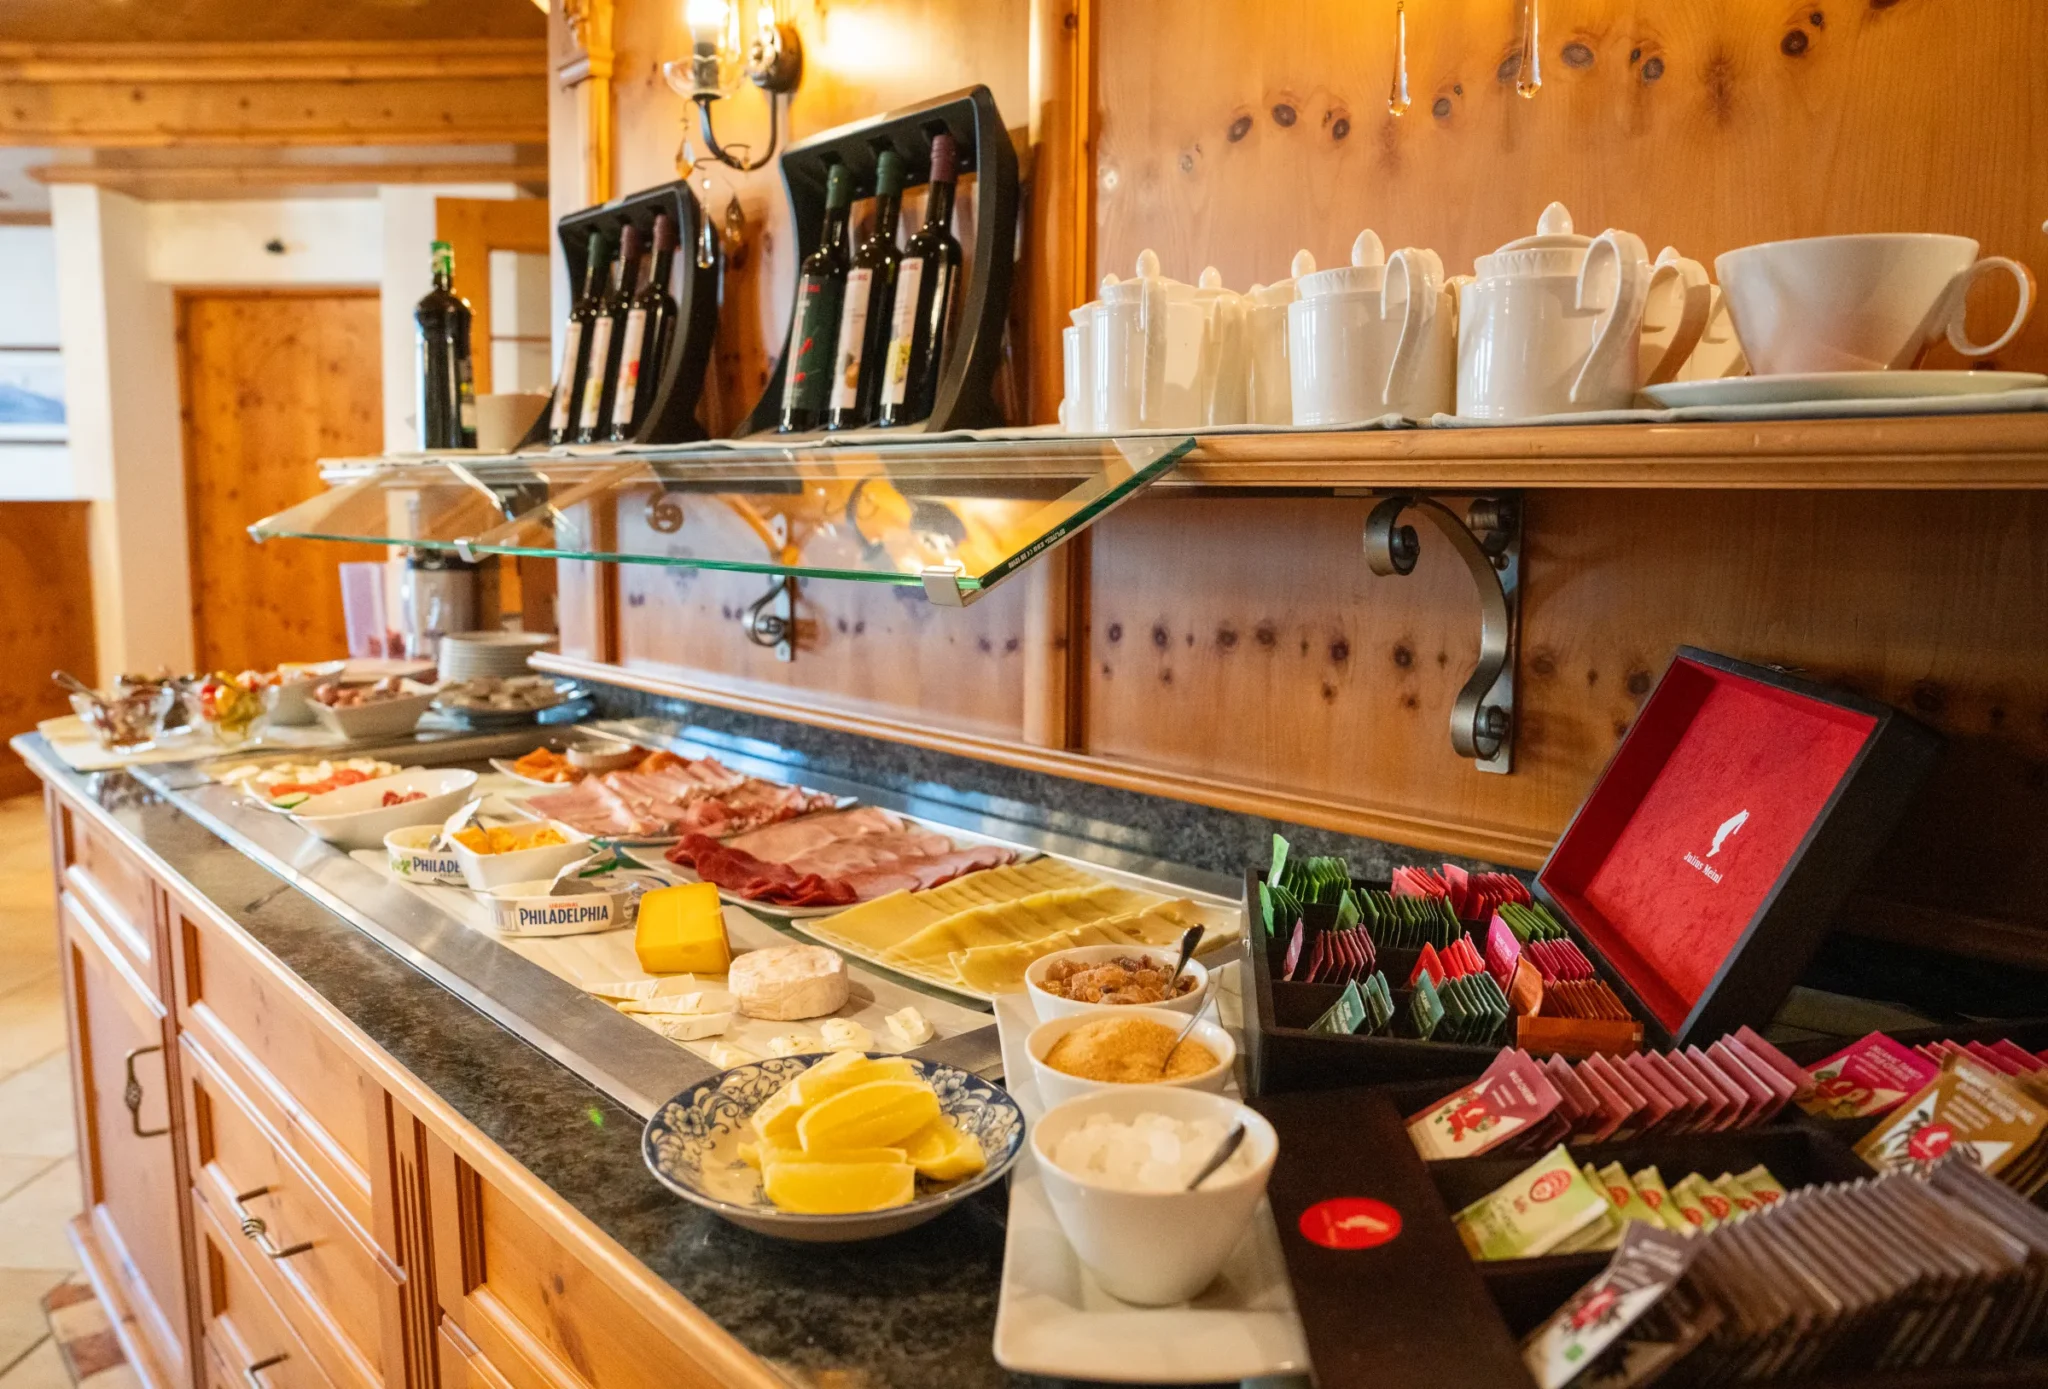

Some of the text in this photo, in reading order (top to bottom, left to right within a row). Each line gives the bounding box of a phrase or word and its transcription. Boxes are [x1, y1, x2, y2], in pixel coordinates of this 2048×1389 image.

[1683, 851, 1723, 884] Julius Meinl
[519, 905, 609, 926] PHILADELPHIA
